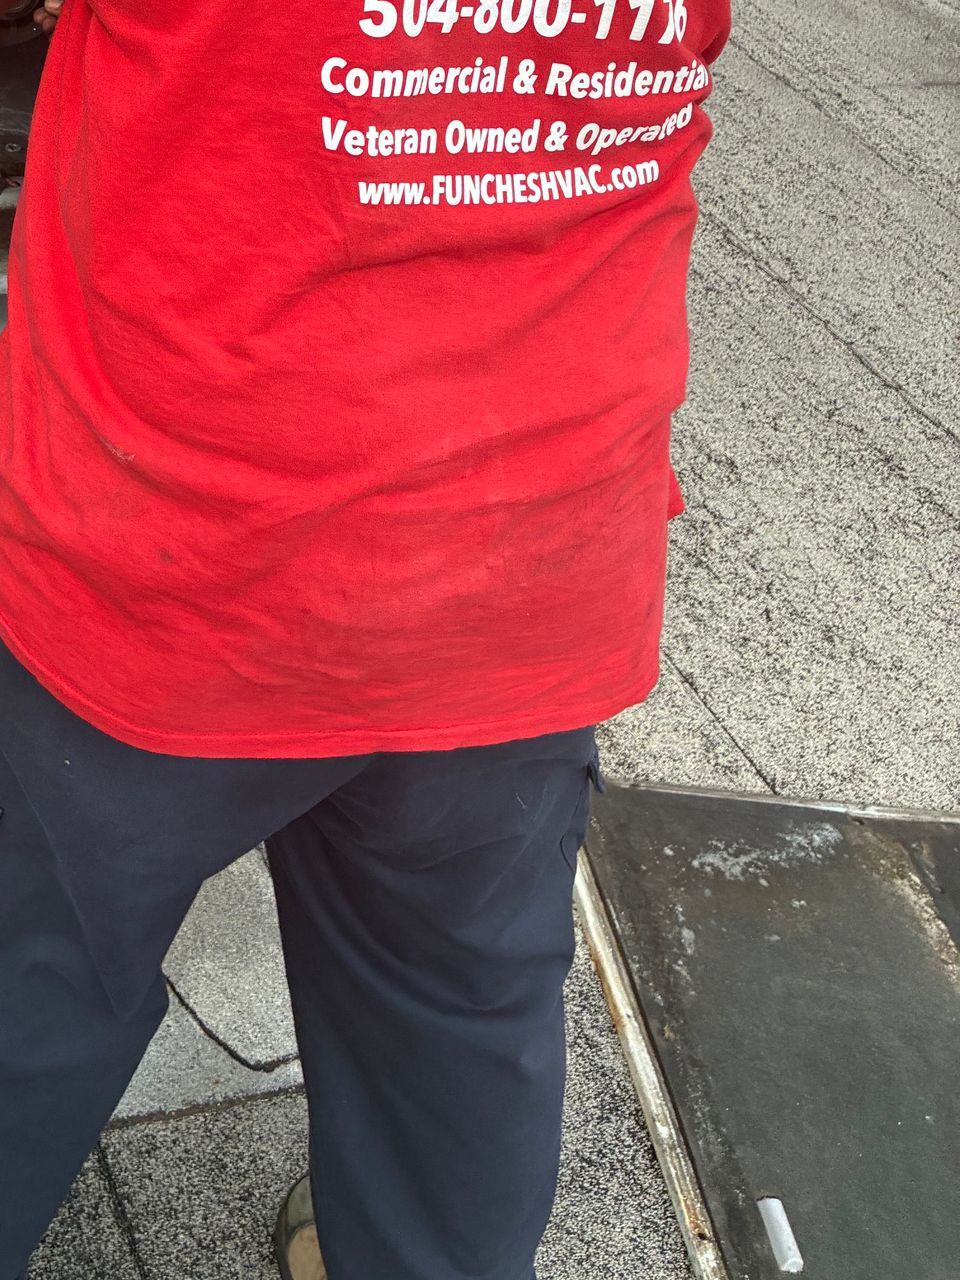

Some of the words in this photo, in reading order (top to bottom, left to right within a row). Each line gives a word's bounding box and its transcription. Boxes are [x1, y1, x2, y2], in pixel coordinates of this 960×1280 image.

[320, 56, 509, 98] Commercial
[513, 58, 538, 95] &
[321, 117, 437, 157] Veteran
[445, 119, 541, 155] Owned
[543, 121, 569, 152] &
[576, 102, 693, 156] Operated
[358, 159, 660, 206] www.FUNCHESHVAC.com
